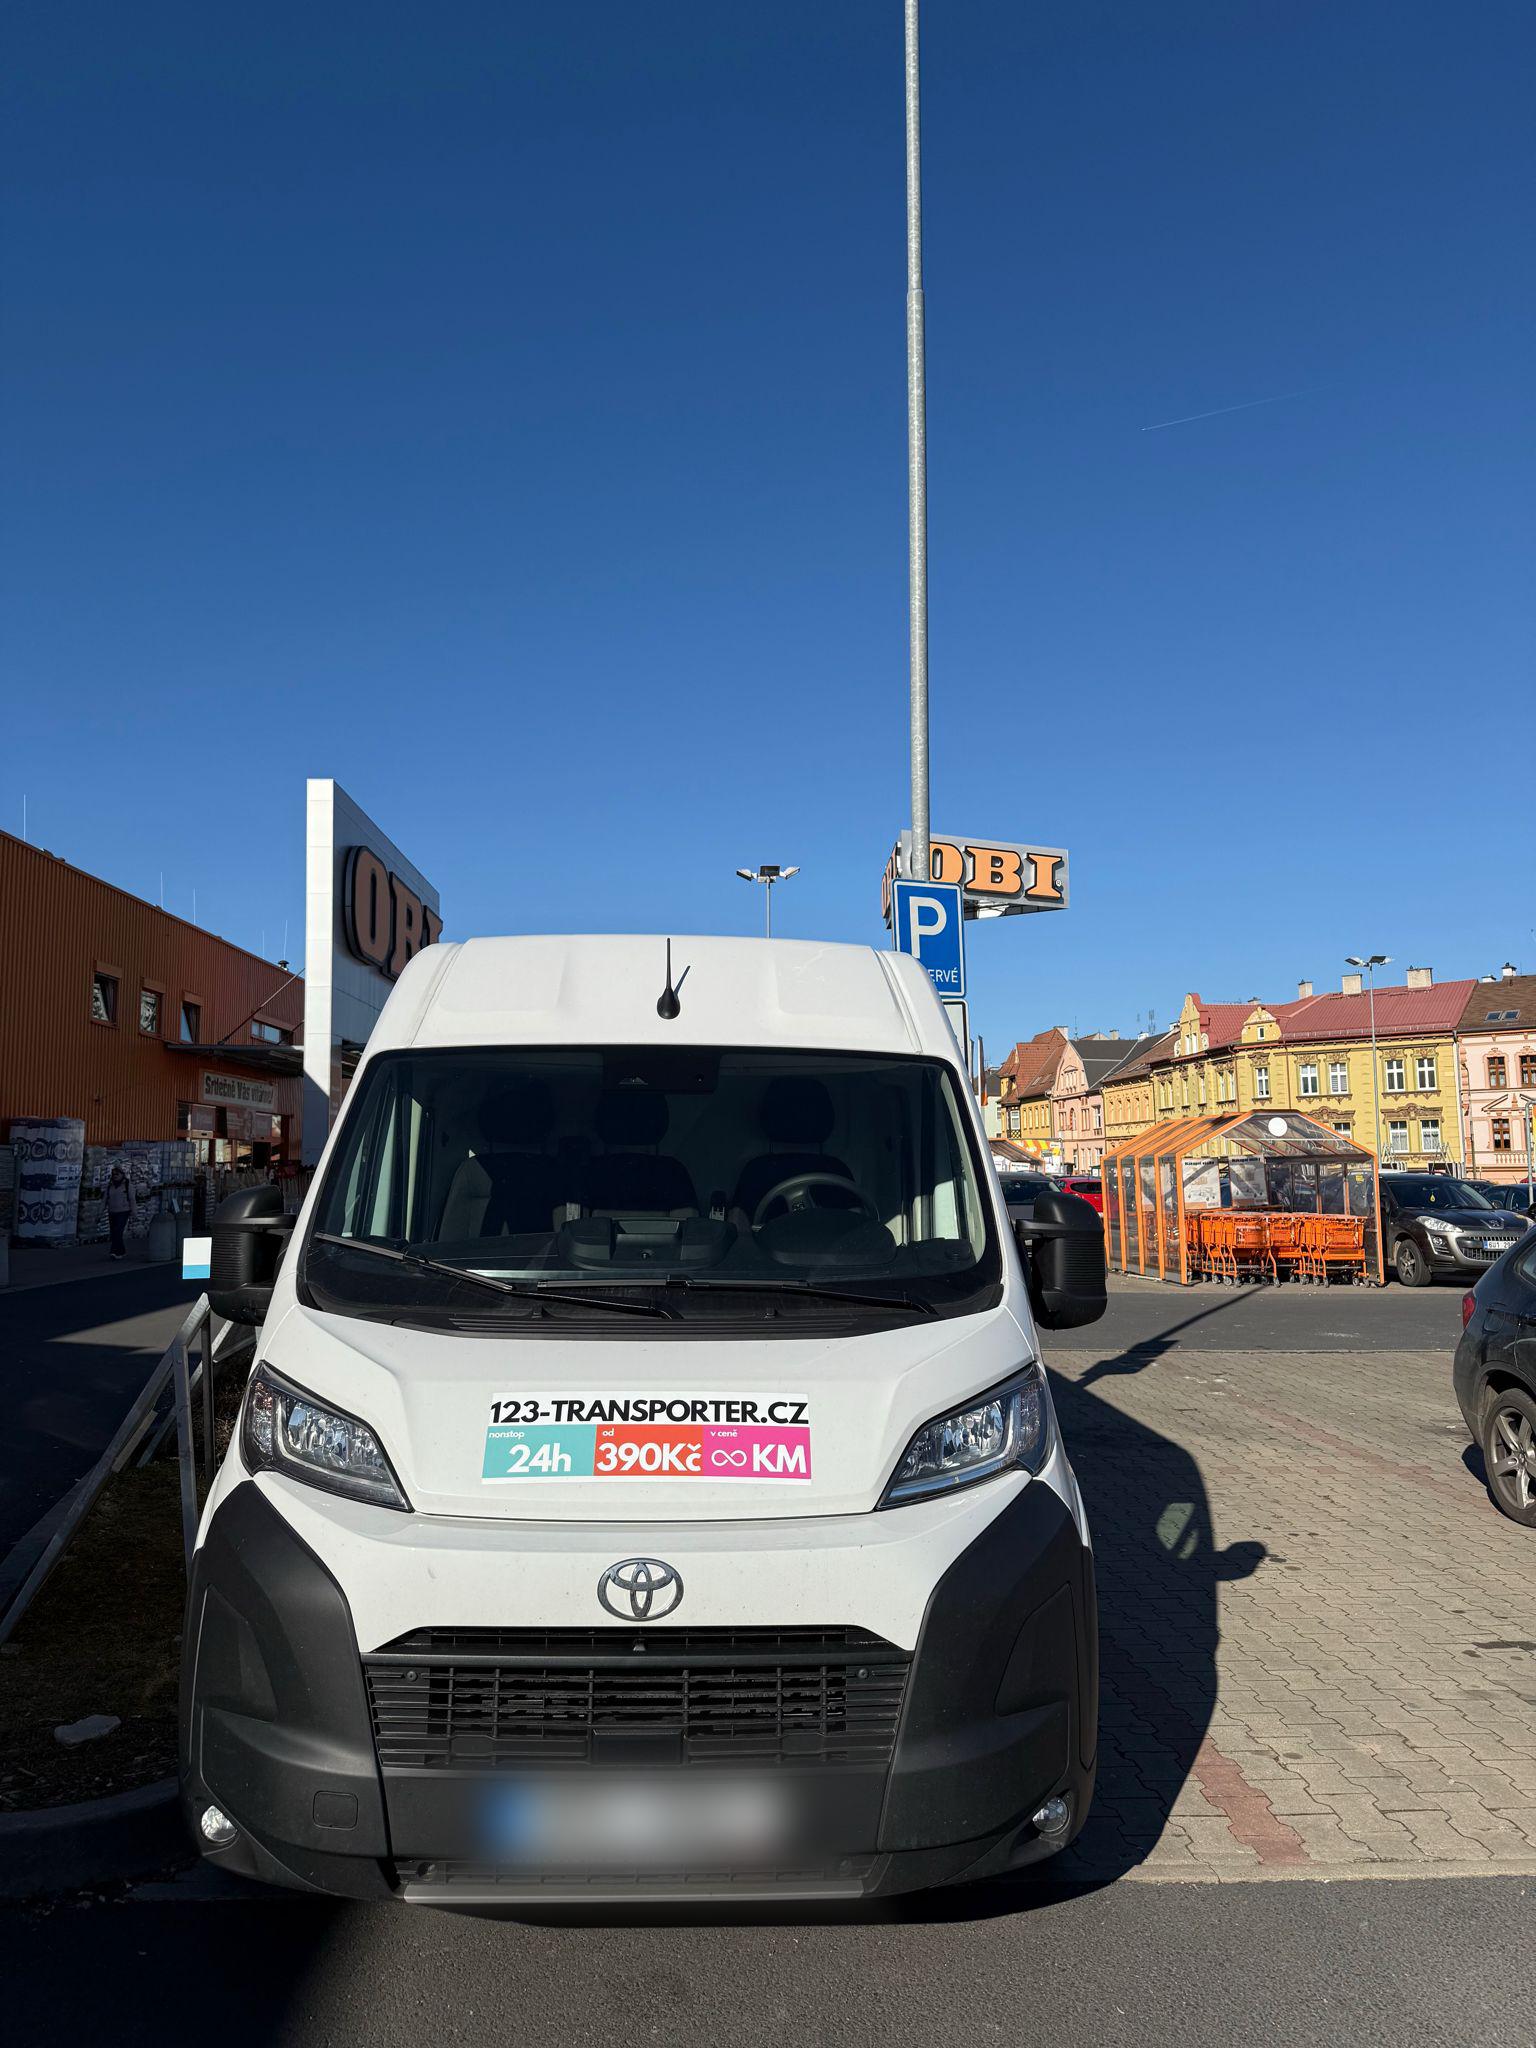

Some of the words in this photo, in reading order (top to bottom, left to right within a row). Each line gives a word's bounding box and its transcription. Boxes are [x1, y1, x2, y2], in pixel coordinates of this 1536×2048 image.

[908, 895, 948, 959] P
[927, 967, 959, 983] ERVÉ
[237, 1081, 251, 1101] Vás
[490, 1399, 809, 1424] 123-TRANSPORTER.CZ
[488, 1430, 525, 1439] nonstop
[602, 1428, 615, 1437] od
[717, 1428, 738, 1437] ceně
[506, 1442, 572, 1473] 24h
[596, 1442, 702, 1472] 390Kč
[752, 1443, 807, 1474] KM
